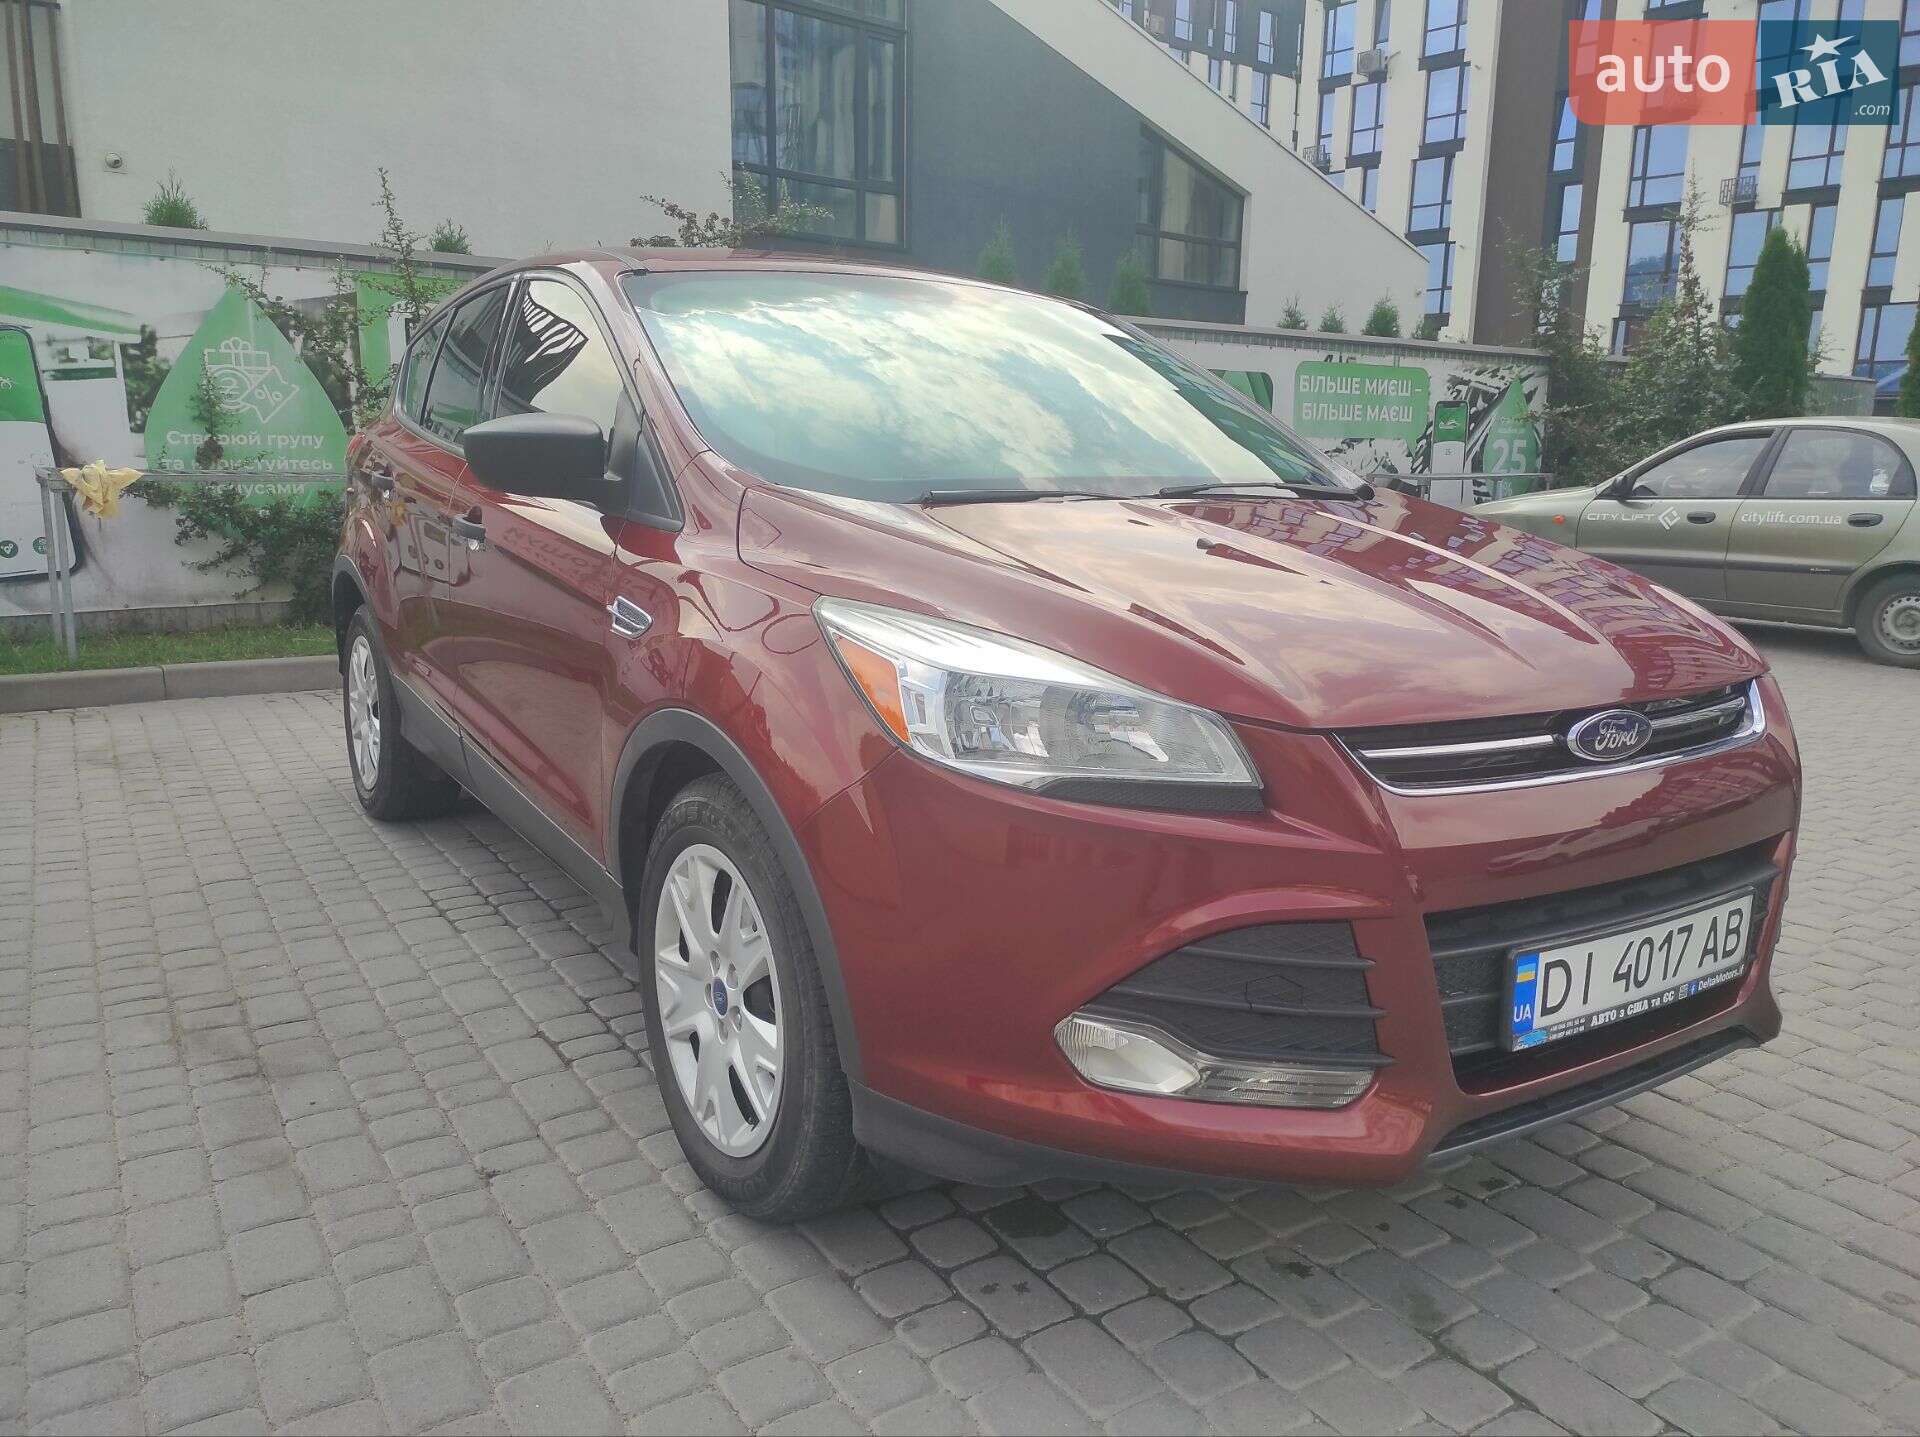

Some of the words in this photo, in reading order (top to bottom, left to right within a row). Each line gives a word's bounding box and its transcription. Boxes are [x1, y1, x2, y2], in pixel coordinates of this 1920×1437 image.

[1300, 375, 1360, 395] БІЛЬШЕ
[1365, 378, 1412, 397] МИЄШ
[1302, 401, 1362, 421] БІЛЬШЕ
[1366, 404, 1413, 422] МАЄШ
[267, 432, 325, 449] групу
[1492, 438, 1527, 474] 25
[1586, 513, 1619, 521] CITY
[1621, 512, 1656, 521] LIFT
[1741, 510, 1841, 525] citylift.com.ua
[1594, 718, 1639, 751] Ford
[1540, 951, 1594, 1018] DI
[1612, 923, 1694, 993] 4017
[1697, 907, 1744, 969] AB
[1513, 1003, 1532, 1023] UA
[1590, 1009, 1617, 1027] АВТО
